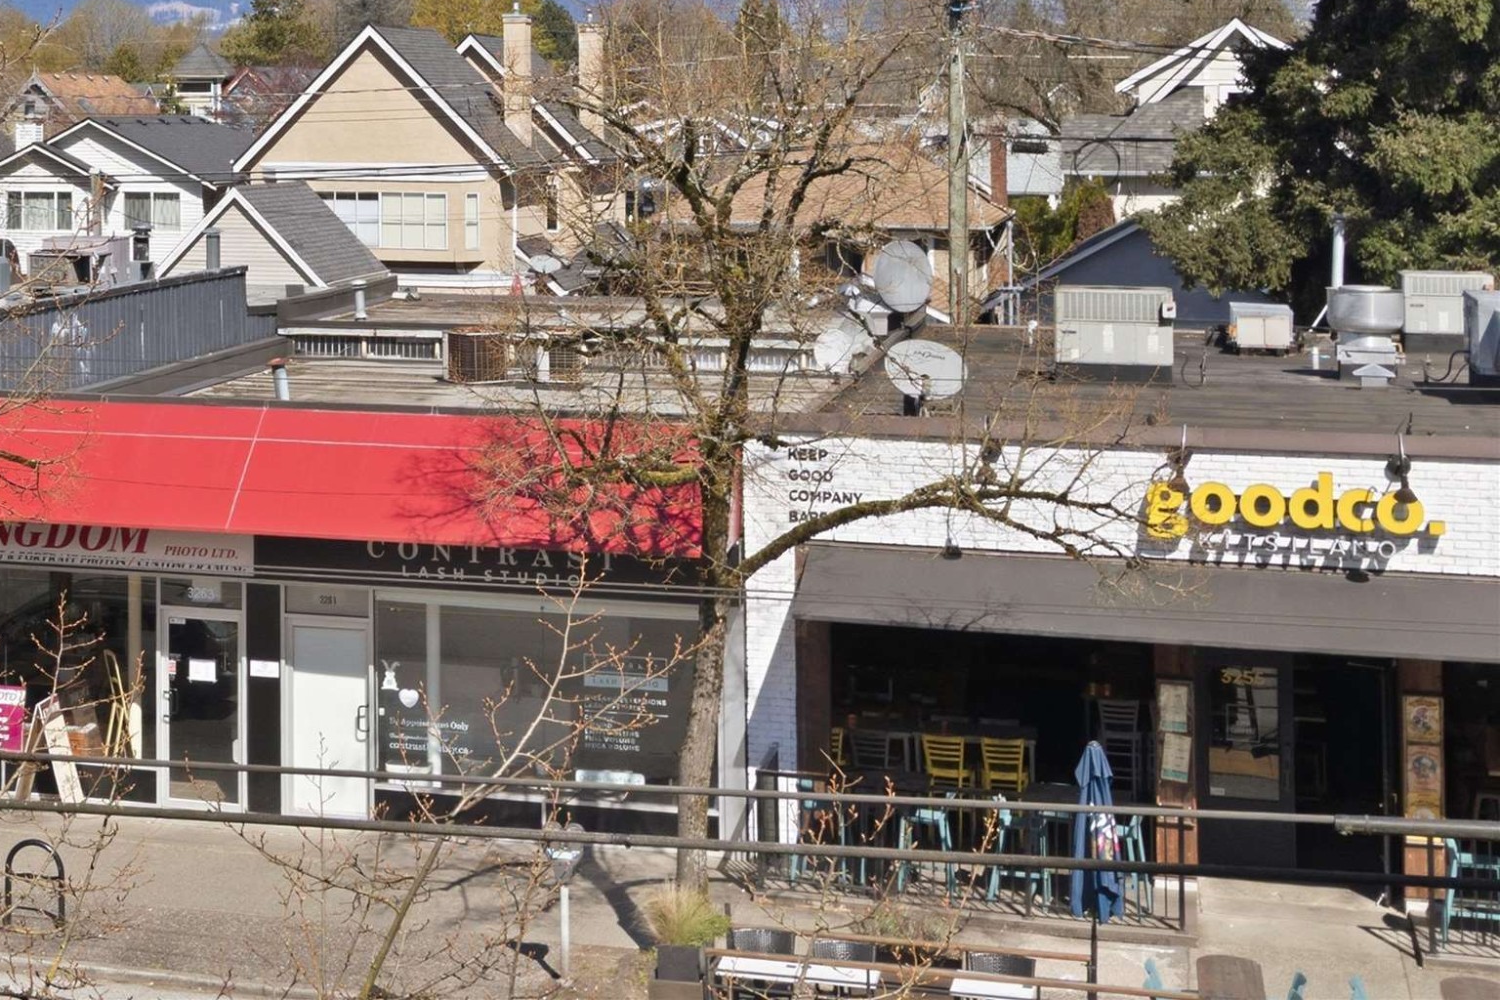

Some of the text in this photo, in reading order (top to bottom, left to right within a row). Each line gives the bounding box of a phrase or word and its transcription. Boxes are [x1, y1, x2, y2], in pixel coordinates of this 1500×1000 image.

[788, 448, 829, 461] KEEP
[788, 469, 833, 482] GOOD
[789, 490, 863, 505] COMPANY
[1147, 471, 1446, 539] goodco.
[1199, 529, 1397, 559] KITSILANO
[164, 545, 209, 557] PHOTO
[211, 548, 239, 560] LTD.
[367, 541, 618, 571] CONTRAST
[402, 565, 581, 588] LASH STUDIO
[450, 720, 469, 732] Only
